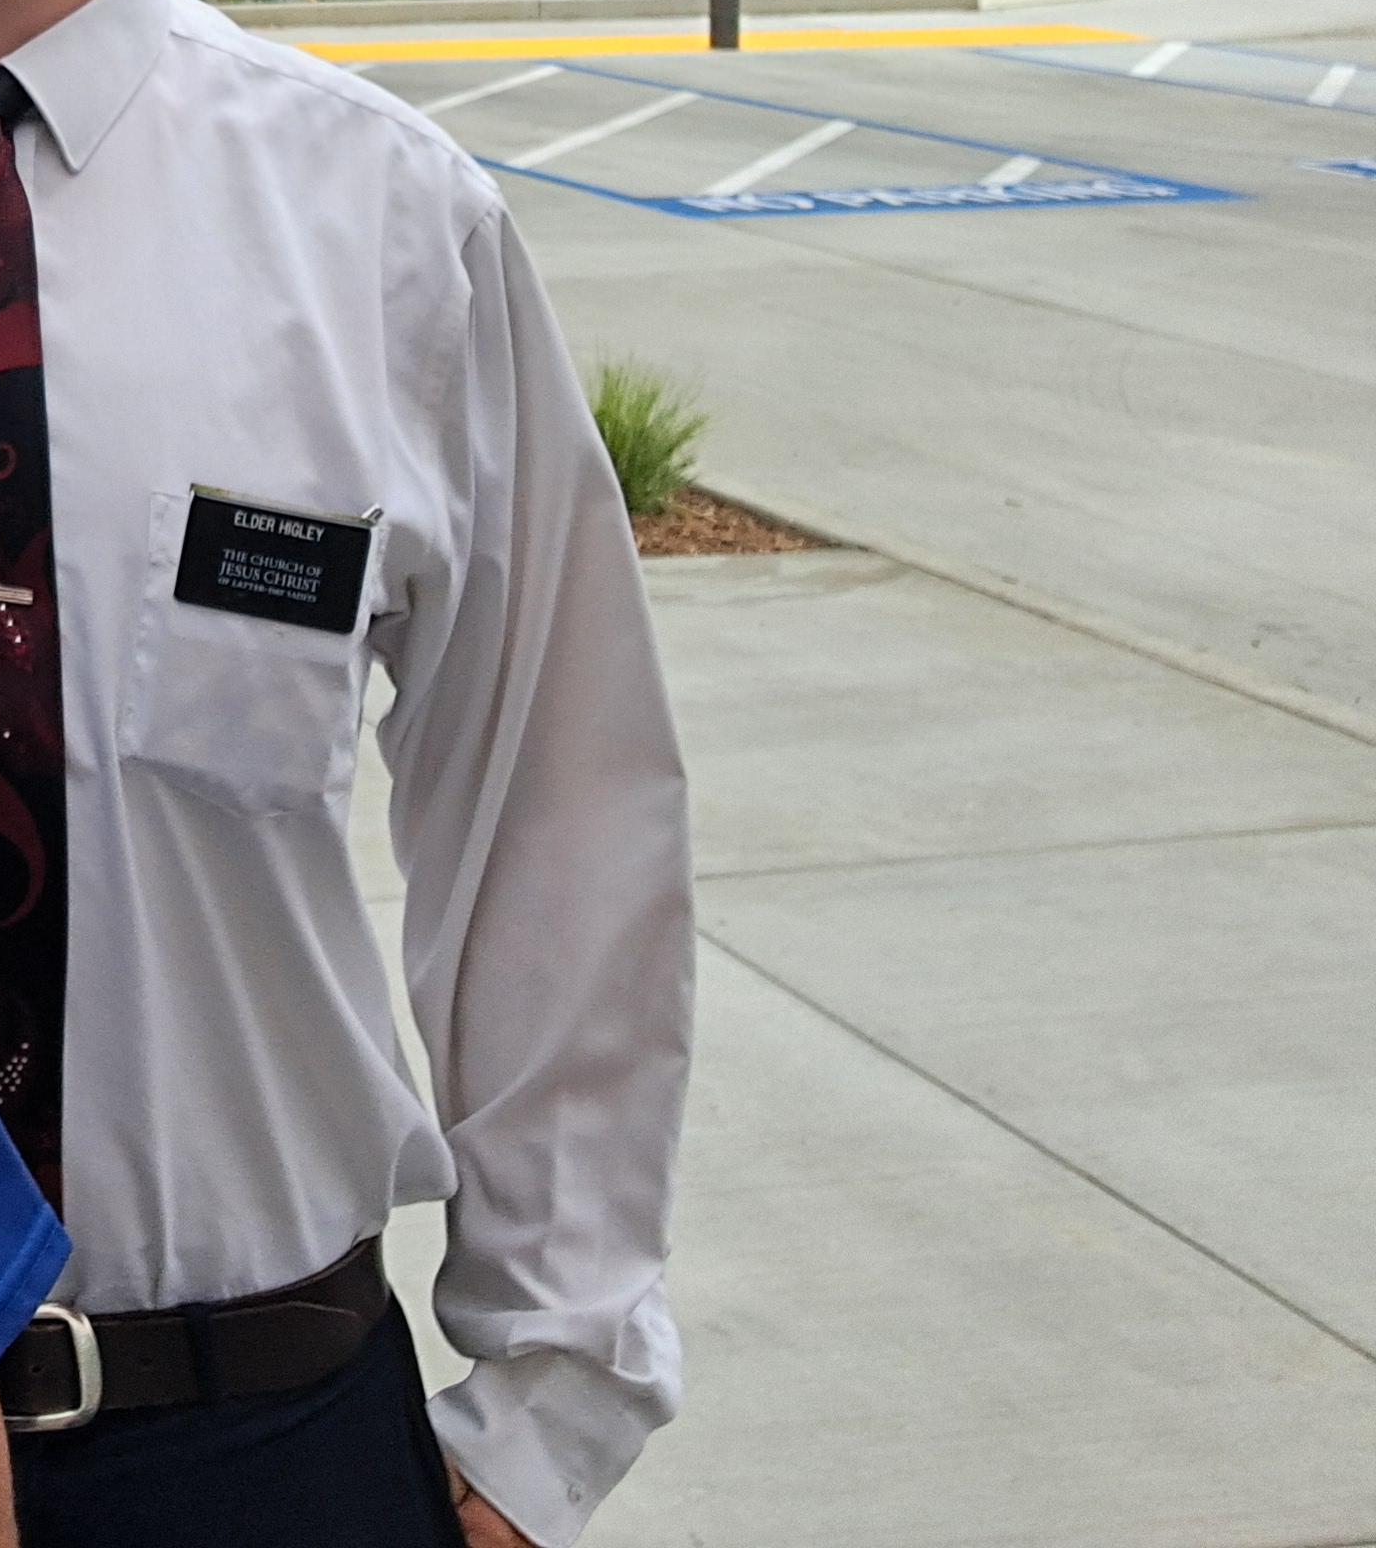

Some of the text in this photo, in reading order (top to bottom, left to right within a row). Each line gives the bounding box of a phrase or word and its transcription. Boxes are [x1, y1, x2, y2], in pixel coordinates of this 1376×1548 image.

[234, 509, 325, 542] ELDER HIGLEY
[218, 560, 321, 593] JESUS CHRIST
[223, 548, 323, 578] THE CHURCH OF
